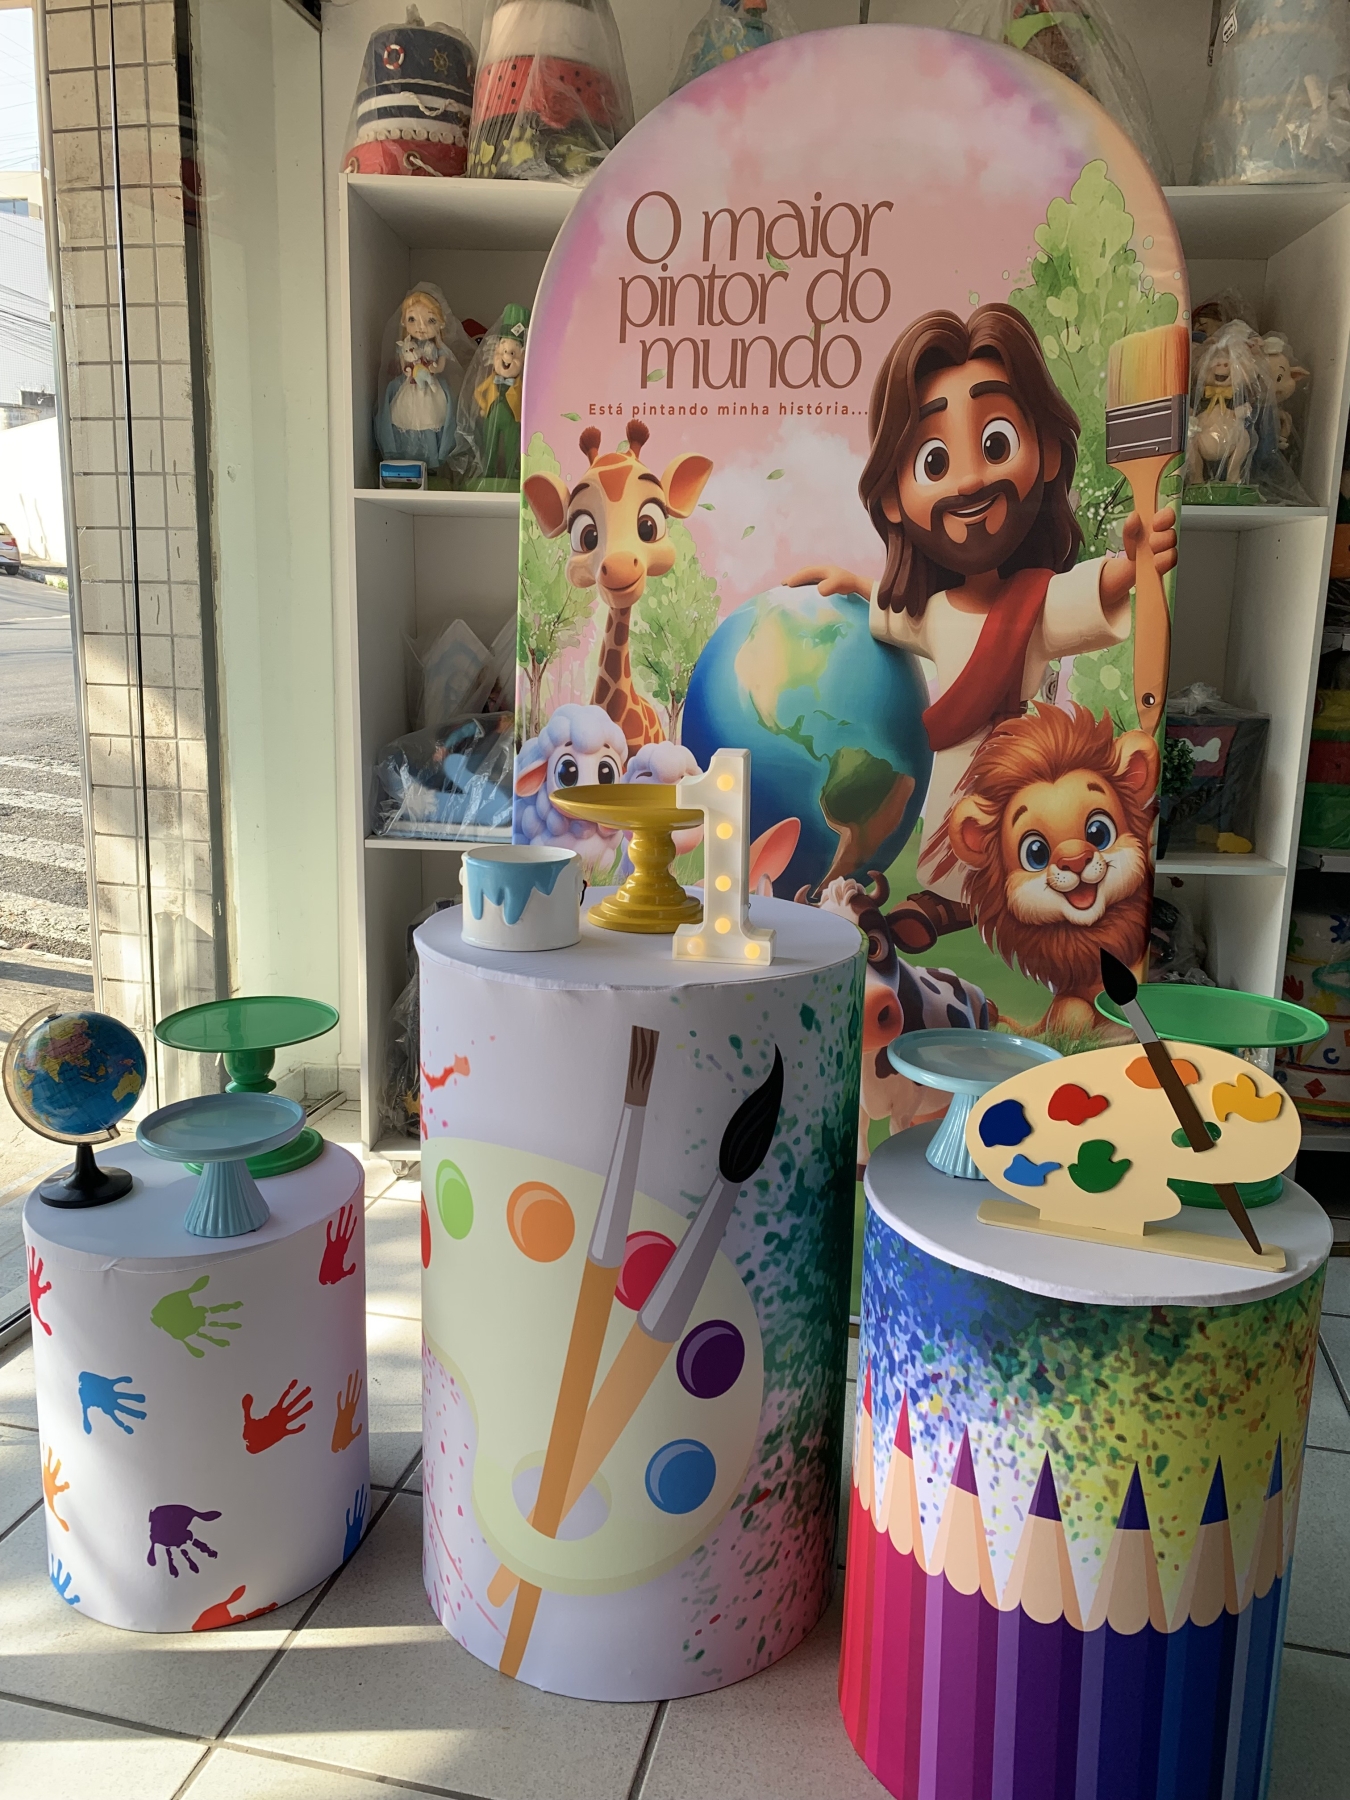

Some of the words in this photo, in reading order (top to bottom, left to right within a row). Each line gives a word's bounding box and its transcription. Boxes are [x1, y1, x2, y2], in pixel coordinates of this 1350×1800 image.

[626, 190, 682, 264] O
[702, 191, 894, 262] maior
[618, 263, 789, 343] pintor
[806, 253, 891, 324] do
[639, 322, 862, 390] mundo
[588, 403, 623, 416] Está
[632, 403, 708, 418] pintando
[717, 403, 769, 416] minha
[778, 402, 868, 416] história...
[672, 748, 776, 966] 1
